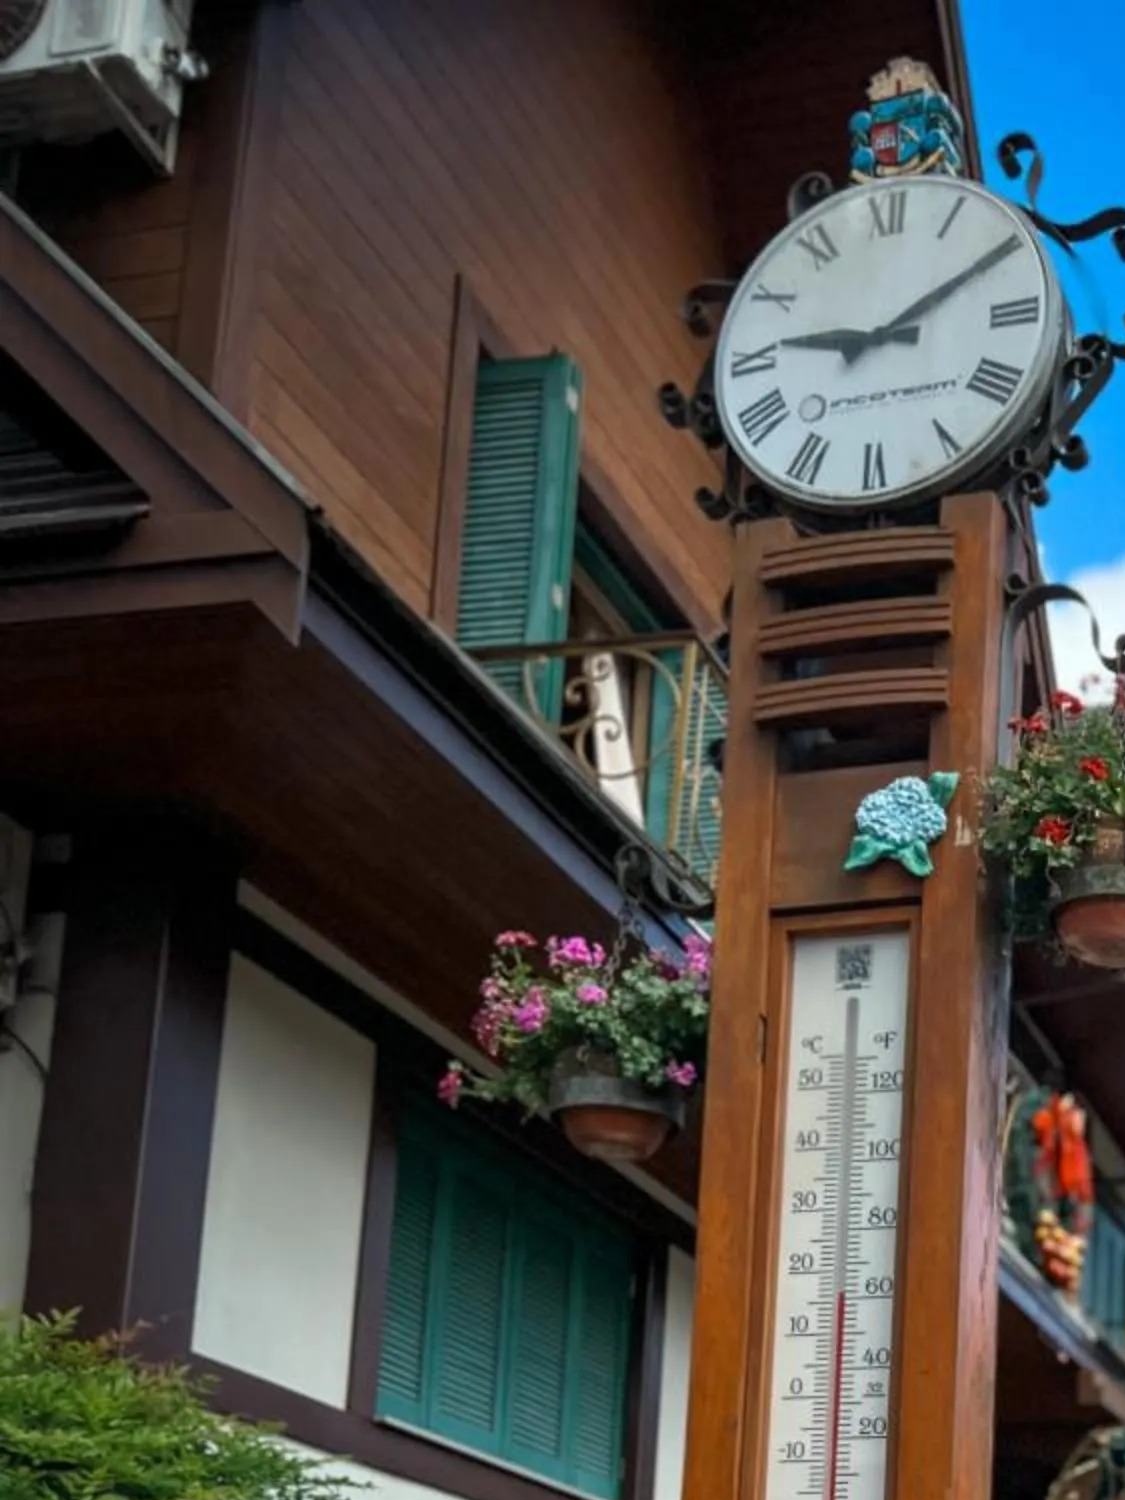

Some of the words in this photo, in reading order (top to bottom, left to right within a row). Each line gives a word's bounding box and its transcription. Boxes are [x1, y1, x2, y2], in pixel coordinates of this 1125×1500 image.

[869, 191, 906, 239] XII
[797, 224, 840, 271] XI
[751, 284, 797, 313] X
[990, 297, 1039, 329] III
[785, 432, 830, 485] VII
[862, 442, 887, 491] VI
[799, 1069, 824, 1086] 50
[796, 1130, 820, 1148] 40
[793, 1191, 817, 1209] 30
[867, 1206, 896, 1226] 80
[789, 1253, 813, 1270] 20
[865, 1276, 893, 1294] 60
[788, 1315, 809, 1333] 10
[862, 1348, 889, 1366] 40
[789, 1377, 803, 1395] 0
[859, 1417, 886, 1436] 20
